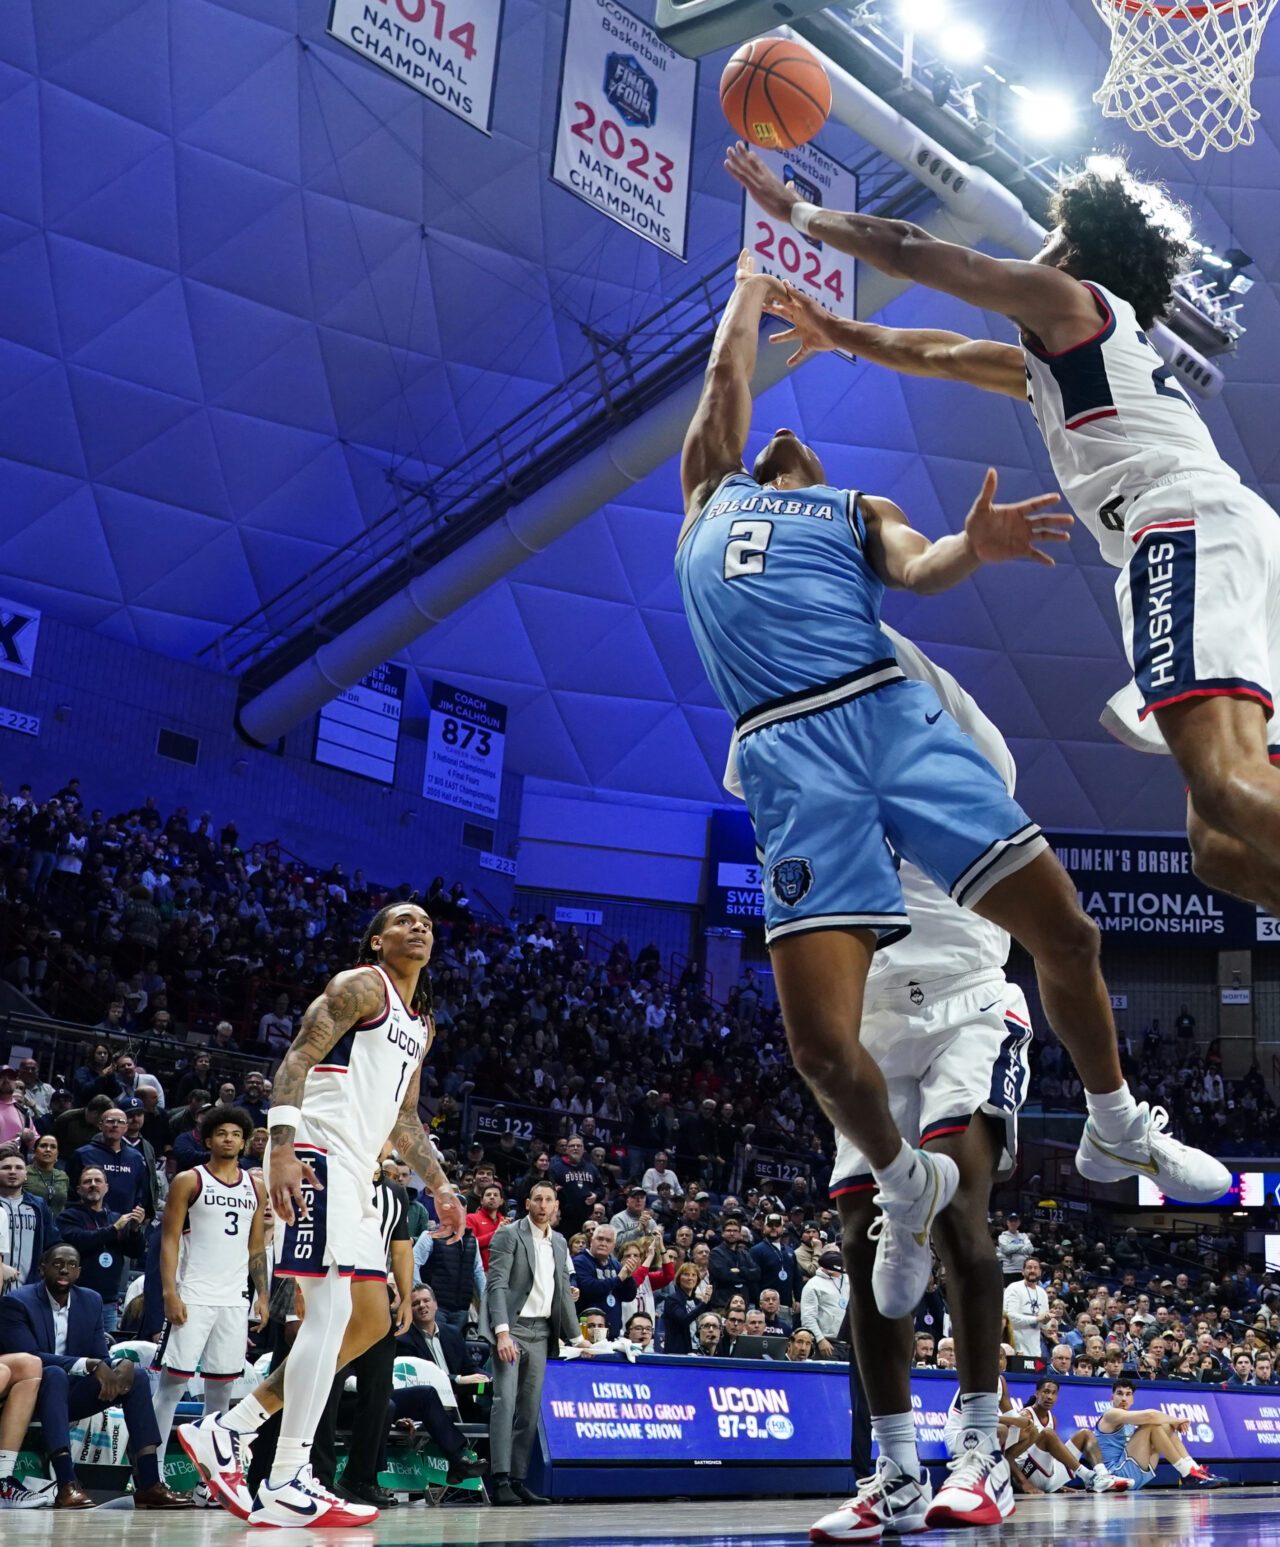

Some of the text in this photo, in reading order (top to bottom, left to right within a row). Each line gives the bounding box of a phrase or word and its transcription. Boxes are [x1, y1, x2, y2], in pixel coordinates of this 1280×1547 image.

[378, 0, 477, 61] 014
[364, 5, 467, 85] NATIONAL
[601, 17, 667, 72] Basketball
[351, 26, 473, 114] CHAMPIONS
[614, 63, 651, 99] FINAL
[616, 82, 652, 114] FOUR
[570, 101, 675, 194] 2023
[809, 150, 840, 177] Men's
[578, 149, 666, 217] NATIONAL
[569, 169, 672, 243] CHAMPIONS
[754, 220, 844, 303] 2024
[705, 496, 834, 521] COLUMBIA
[723, 519, 775, 582] 2
[1148, 542, 1175, 688] HUSKIES
[438, 699, 500, 728] JIM CALHOUN
[454, 692, 487, 712] COACH
[8, 713, 38, 733] 222
[442, 718, 492, 757] 873
[445, 779, 459, 790] EAST
[495, 859, 517, 873] 223
[1055, 847, 1194, 873] WOMEN'S BASKE
[745, 868, 763, 885] 3
[727, 890, 764, 905] SWE
[1078, 891, 1223, 916] ATIONAL
[1095, 916, 1225, 934] AMPIONSHIPS
[1222, 992, 1249, 1001] NORTH
[395, 1061, 408, 1102] 1
[131, 1098, 138, 1107] C
[478, 1116, 534, 1139] SEC 122
[757, 1163, 799, 1181] SEC 122
[204, 1194, 257, 1211] UCONN
[294, 1157, 317, 1260] HSKIES
[1049, 1208, 1064, 1221] 123
[224, 1211, 240, 1236] 3
[592, 1382, 651, 1399] LISTEN TO
[708, 1386, 790, 1414] UCONN
[551, 1400, 696, 1421] THE HARTE AUTO GROUP
[1073, 1413, 1088, 1428] THE
[1160, 1402, 1210, 1422] UCONN
[1258, 1407, 1277, 1419] LISTEN
[575, 1421, 682, 1439] POSTGAME SHOW
[717, 1414, 758, 1438] 97-9
[1245, 1419, 1256, 1430] THE
[14, 1456, 36, 1472] ank
[396, 1462, 423, 1476] Bank
